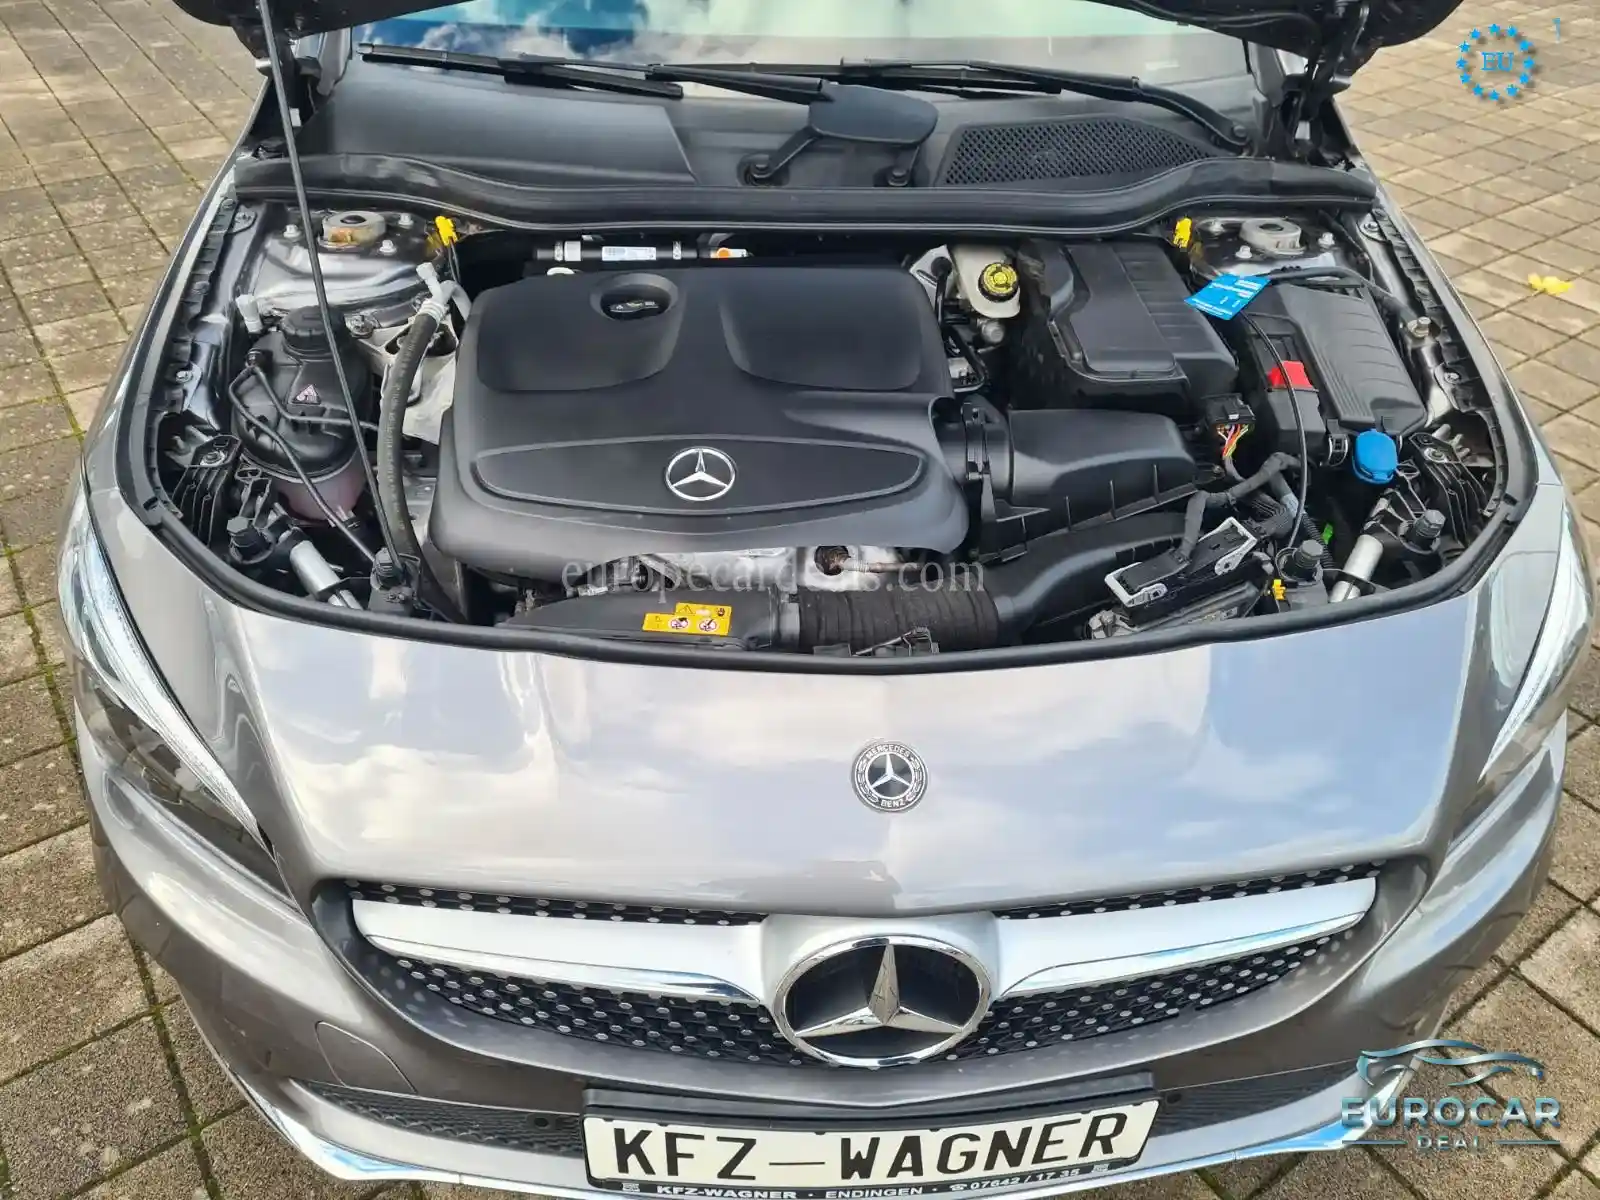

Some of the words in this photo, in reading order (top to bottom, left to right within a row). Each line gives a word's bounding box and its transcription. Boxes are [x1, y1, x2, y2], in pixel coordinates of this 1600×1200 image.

[866, 744, 911, 759] MERCEDES
[881, 798, 906, 808] BENZ
[656, 1185, 797, 1199] KFZ-WAGNER
[825, 1187, 923, 1199] ENDINGEN
